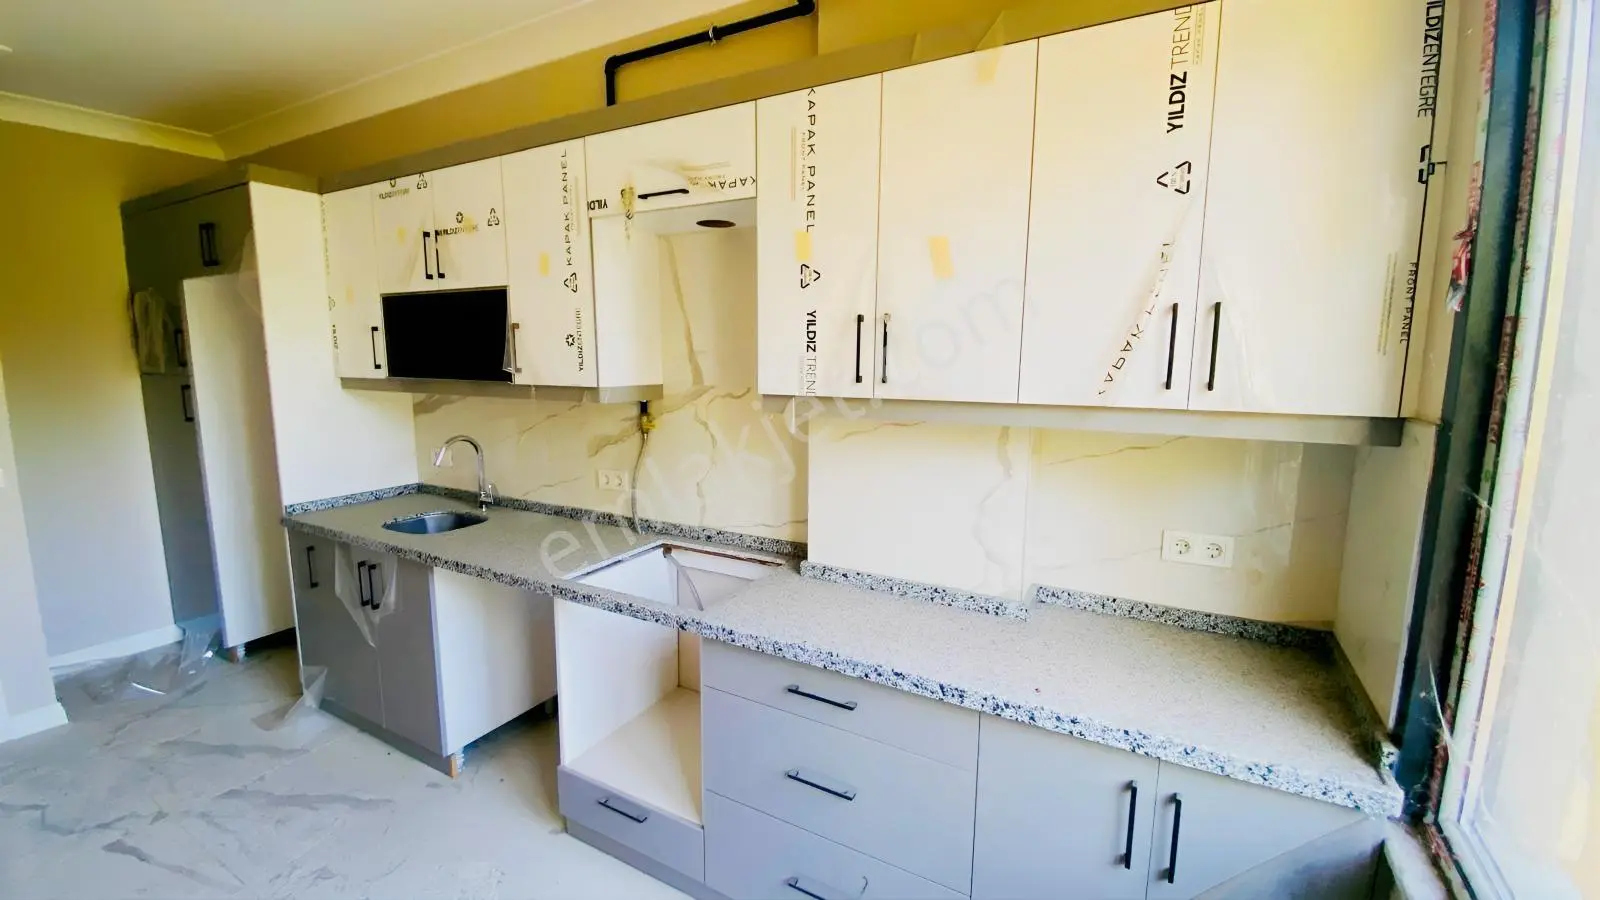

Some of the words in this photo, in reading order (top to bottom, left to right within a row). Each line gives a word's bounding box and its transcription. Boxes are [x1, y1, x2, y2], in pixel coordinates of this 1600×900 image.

[1417, 0, 1443, 118] ILDIZENTEGRE
[1166, 71, 1187, 134] YILDIZ
[560, 149, 569, 205] PANEL
[806, 166, 816, 233] PANEL
[564, 211, 573, 266] KAPAK
[807, 310, 817, 353] YILDIZ
[1399, 306, 1412, 345] PANEL
[1099, 324, 1144, 396] APAK
